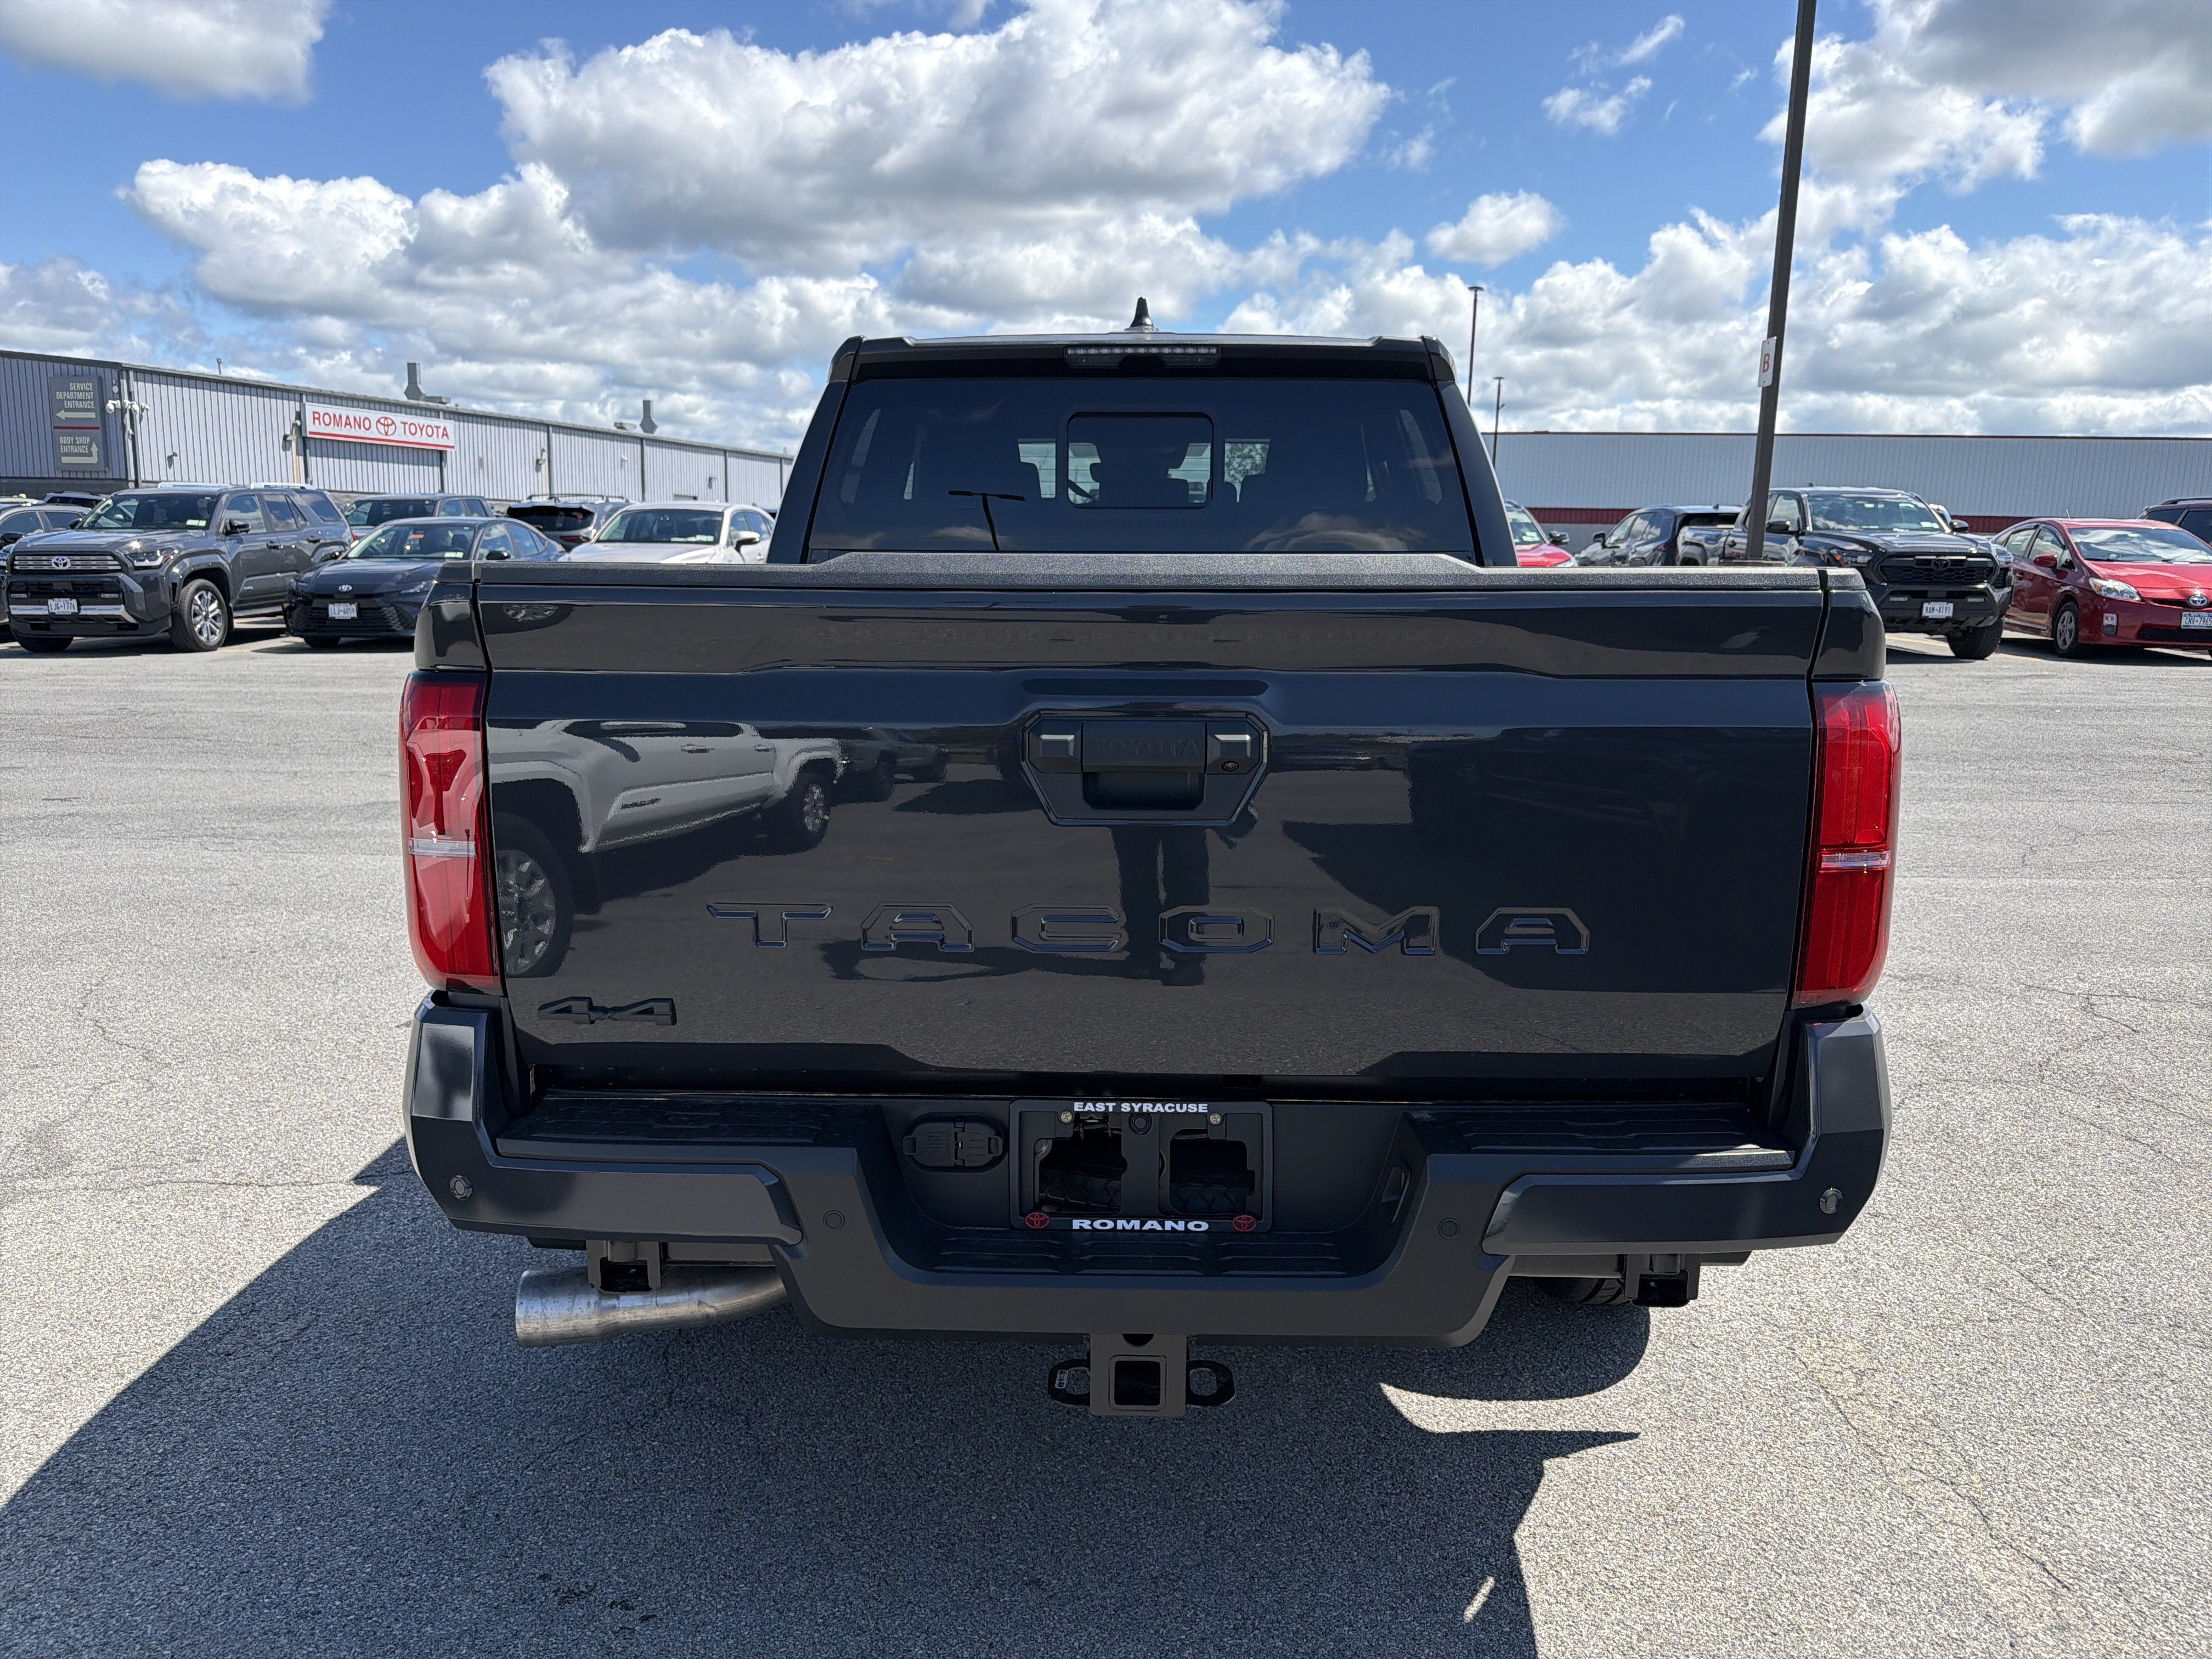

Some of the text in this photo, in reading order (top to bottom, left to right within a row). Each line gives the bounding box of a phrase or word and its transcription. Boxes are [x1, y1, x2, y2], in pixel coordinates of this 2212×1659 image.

[1763, 353, 1770, 373] B
[69, 382, 93, 391] SERVICE
[64, 400, 94, 409] ENTRANCE
[312, 411, 449, 439] ROMANO TOYOTA
[60, 445, 89, 453] ENTRANCE
[1096, 737, 1200, 757] TOYOTA
[706, 901, 1590, 956] TACOMA
[1074, 1102, 1208, 1113] EAST SYRACUSE
[1072, 1219, 1209, 1231] ROMANO
